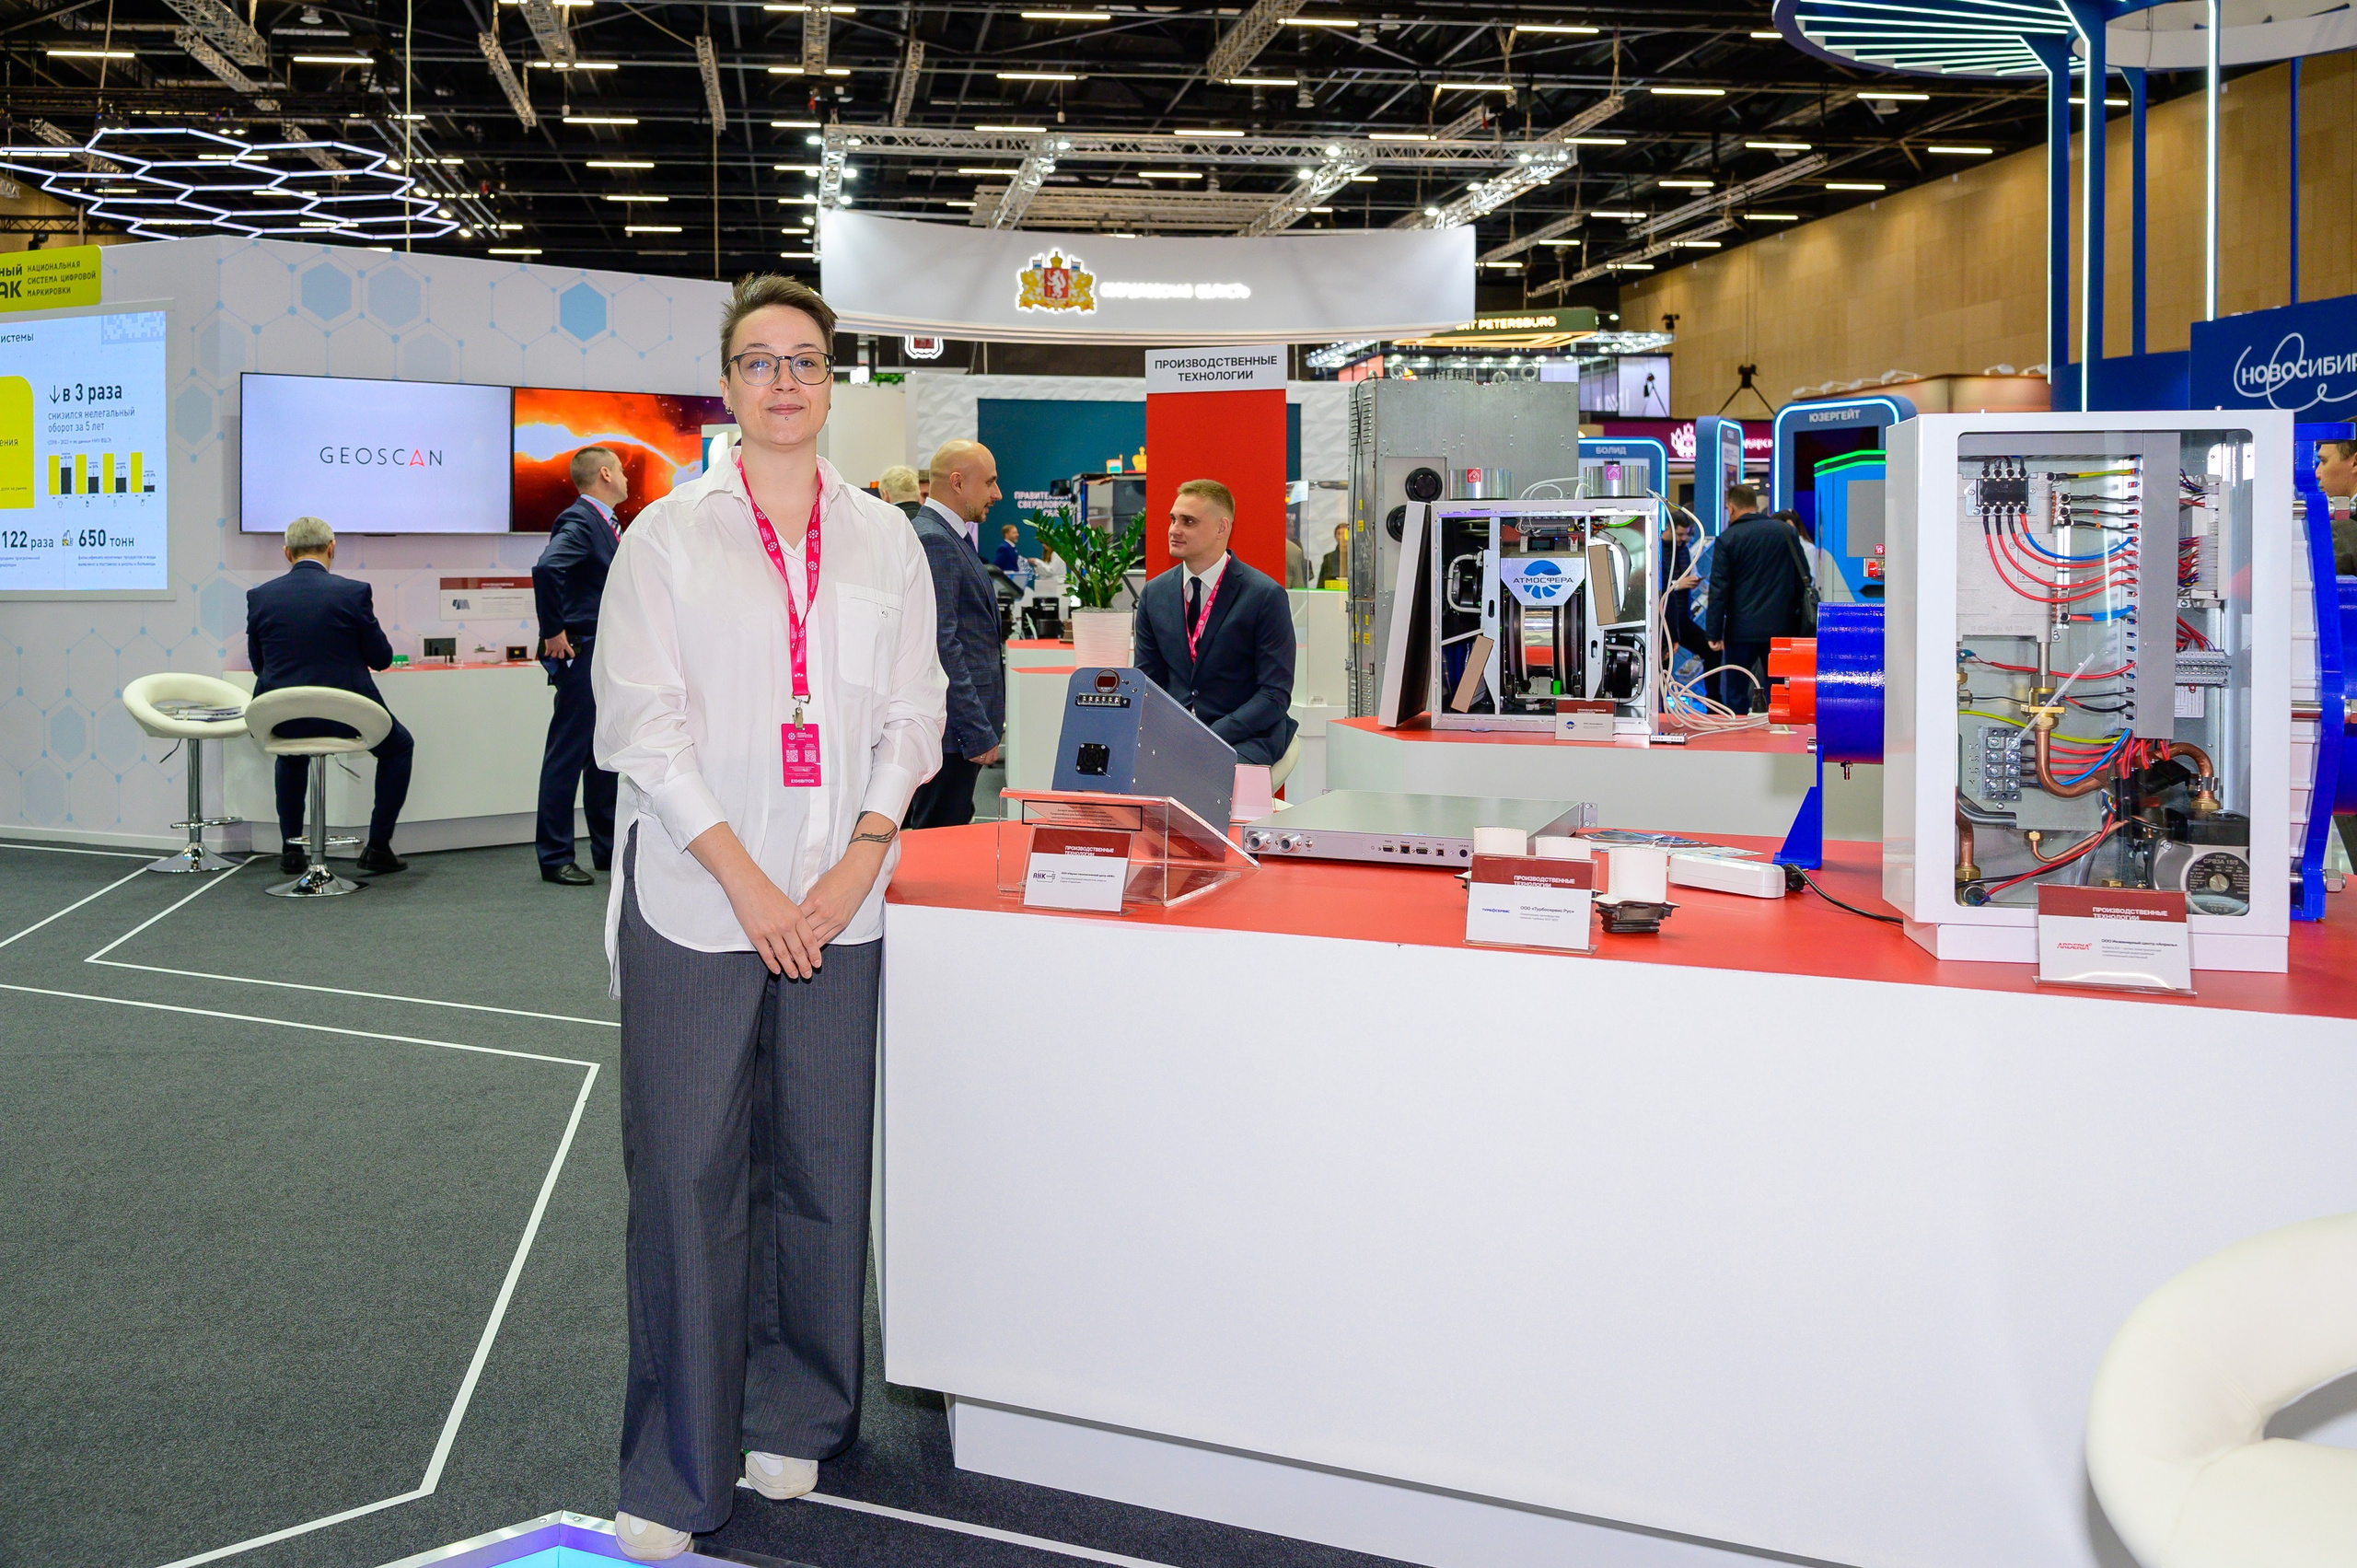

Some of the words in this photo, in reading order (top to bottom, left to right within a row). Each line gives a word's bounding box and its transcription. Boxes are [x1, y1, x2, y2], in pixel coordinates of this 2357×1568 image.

[28, 261, 81, 273] НАЦИОНАЛЬНАЯ
[28, 275, 58, 285] СИСТЕМА
[61, 271, 97, 283] ЦИФРОВОЙ
[28, 286, 72, 297] МАРКИРОВКИ
[1478, 316, 1557, 331] PETERSBURG
[1155, 355, 1278, 369] ПРОИЗВОДСТВЕННЫЕ
[1178, 370, 1254, 382] ТЕХНОЛОГИИ
[63, 388, 71, 402] в
[75, 383, 84, 401] 3
[88, 385, 122, 406] раза
[48, 411, 83, 422] снизился
[85, 406, 135, 420] нелегальный
[1809, 409, 1862, 424] ЮЗЕРГЕЙТ
[48, 423, 74, 435] оборот
[75, 424, 84, 432] за
[85, 421, 90, 431] 5
[91, 422, 105, 431] лет
[320, 447, 442, 467] GEOSCAN
[1595, 446, 1627, 457] БОЛИД
[2, 530, 28, 549] 122
[30, 538, 54, 551] раза
[78, 529, 106, 548] 650
[109, 537, 134, 548] тонн
[1064, 844, 1115, 854] ПРОИЗВОДСТВЕННЫЕ
[1514, 875, 1575, 885] ПРОИЗВОДСТВЕННЫЕ
[2092, 906, 2169, 917] ПРОИЗВОДСТВЕННЫЕ
[2093, 913, 2141, 922] ТЕХНОЛОГИИ
